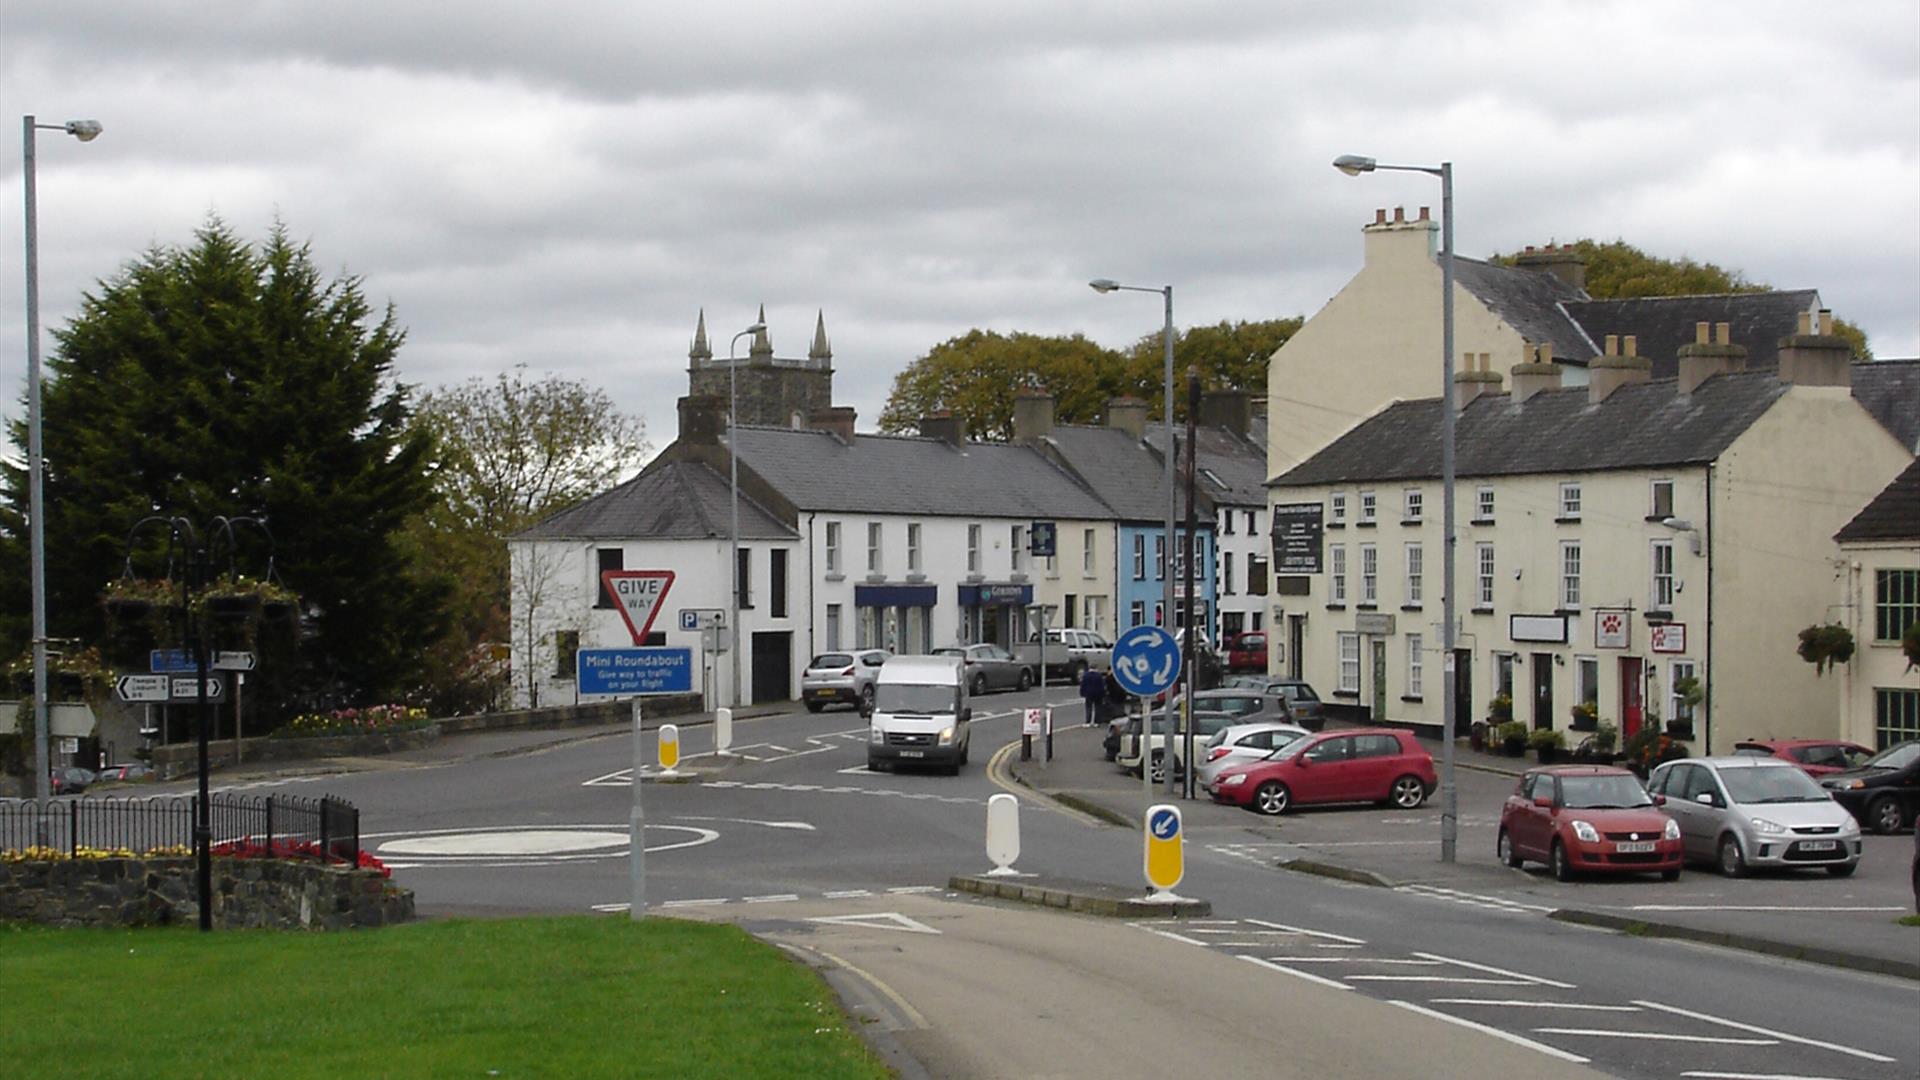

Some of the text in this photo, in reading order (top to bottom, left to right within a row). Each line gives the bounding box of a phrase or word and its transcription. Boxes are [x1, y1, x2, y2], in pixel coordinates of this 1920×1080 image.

[618, 580, 658, 594] GIVE
[628, 599, 652, 609] WAY
[685, 614, 695, 628] P
[586, 655, 684, 667] Mini Roundabout
[598, 669, 672, 680] Give way to traffic
[621, 681, 638, 689] your
[642, 680, 663, 689] Right
